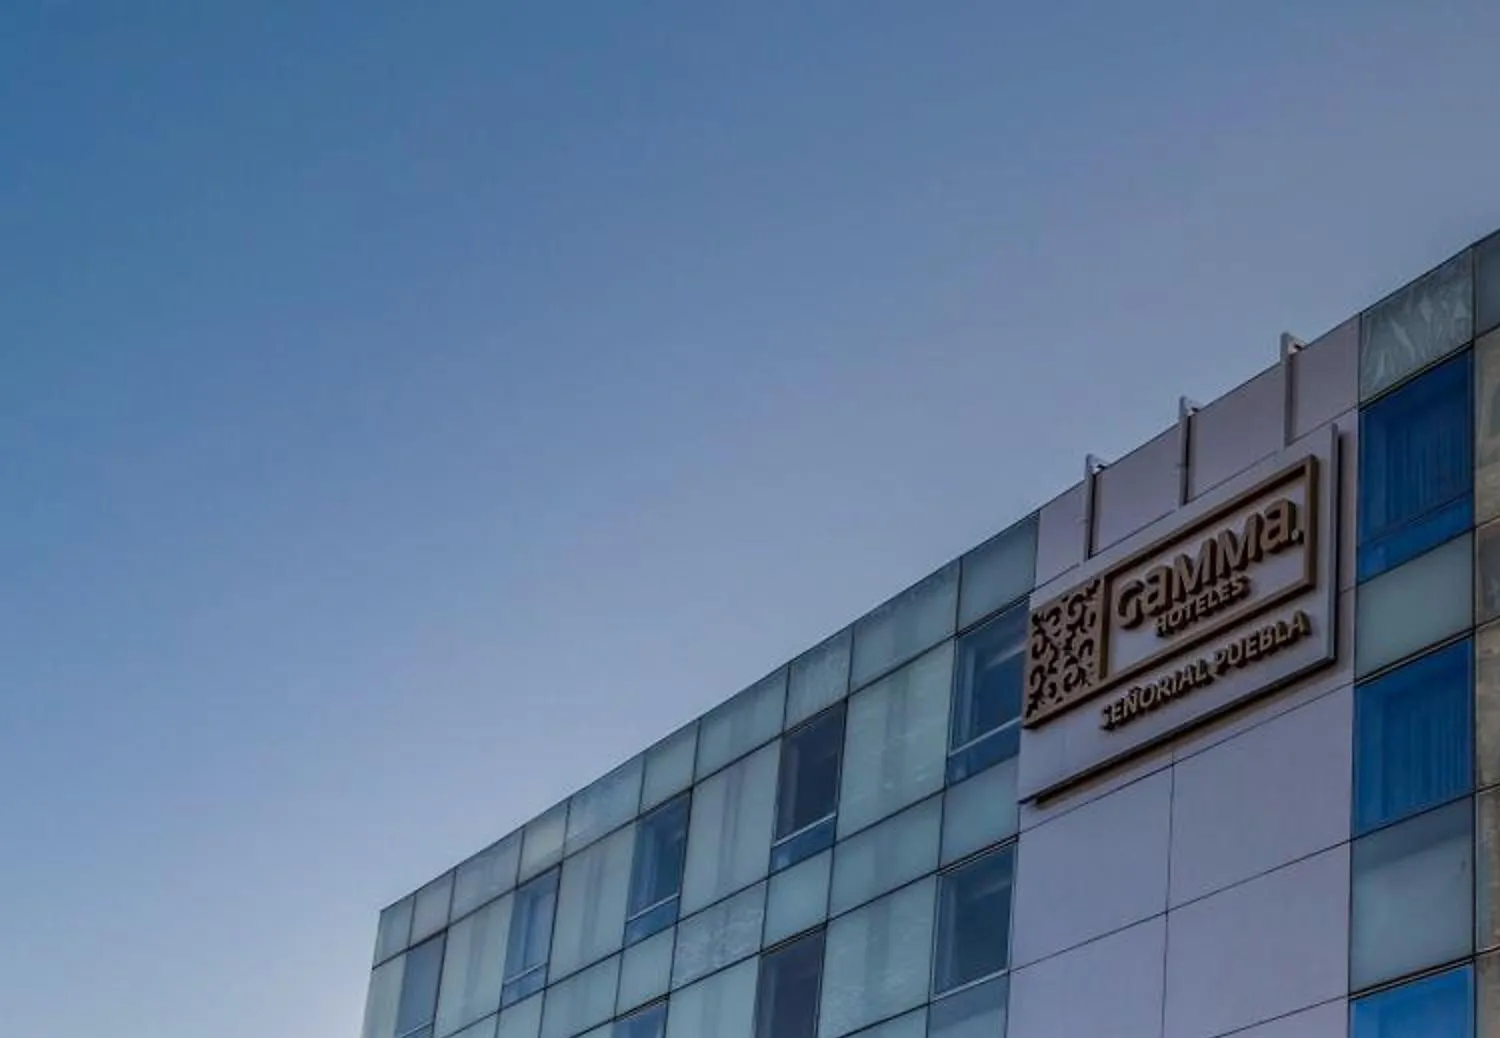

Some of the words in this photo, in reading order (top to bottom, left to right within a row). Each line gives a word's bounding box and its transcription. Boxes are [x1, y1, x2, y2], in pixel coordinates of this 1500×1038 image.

[1156, 574, 1252, 638] HOTELES
[1101, 658, 1211, 730] SEÑORIAL
[1209, 609, 1313, 677] PUEBLA
